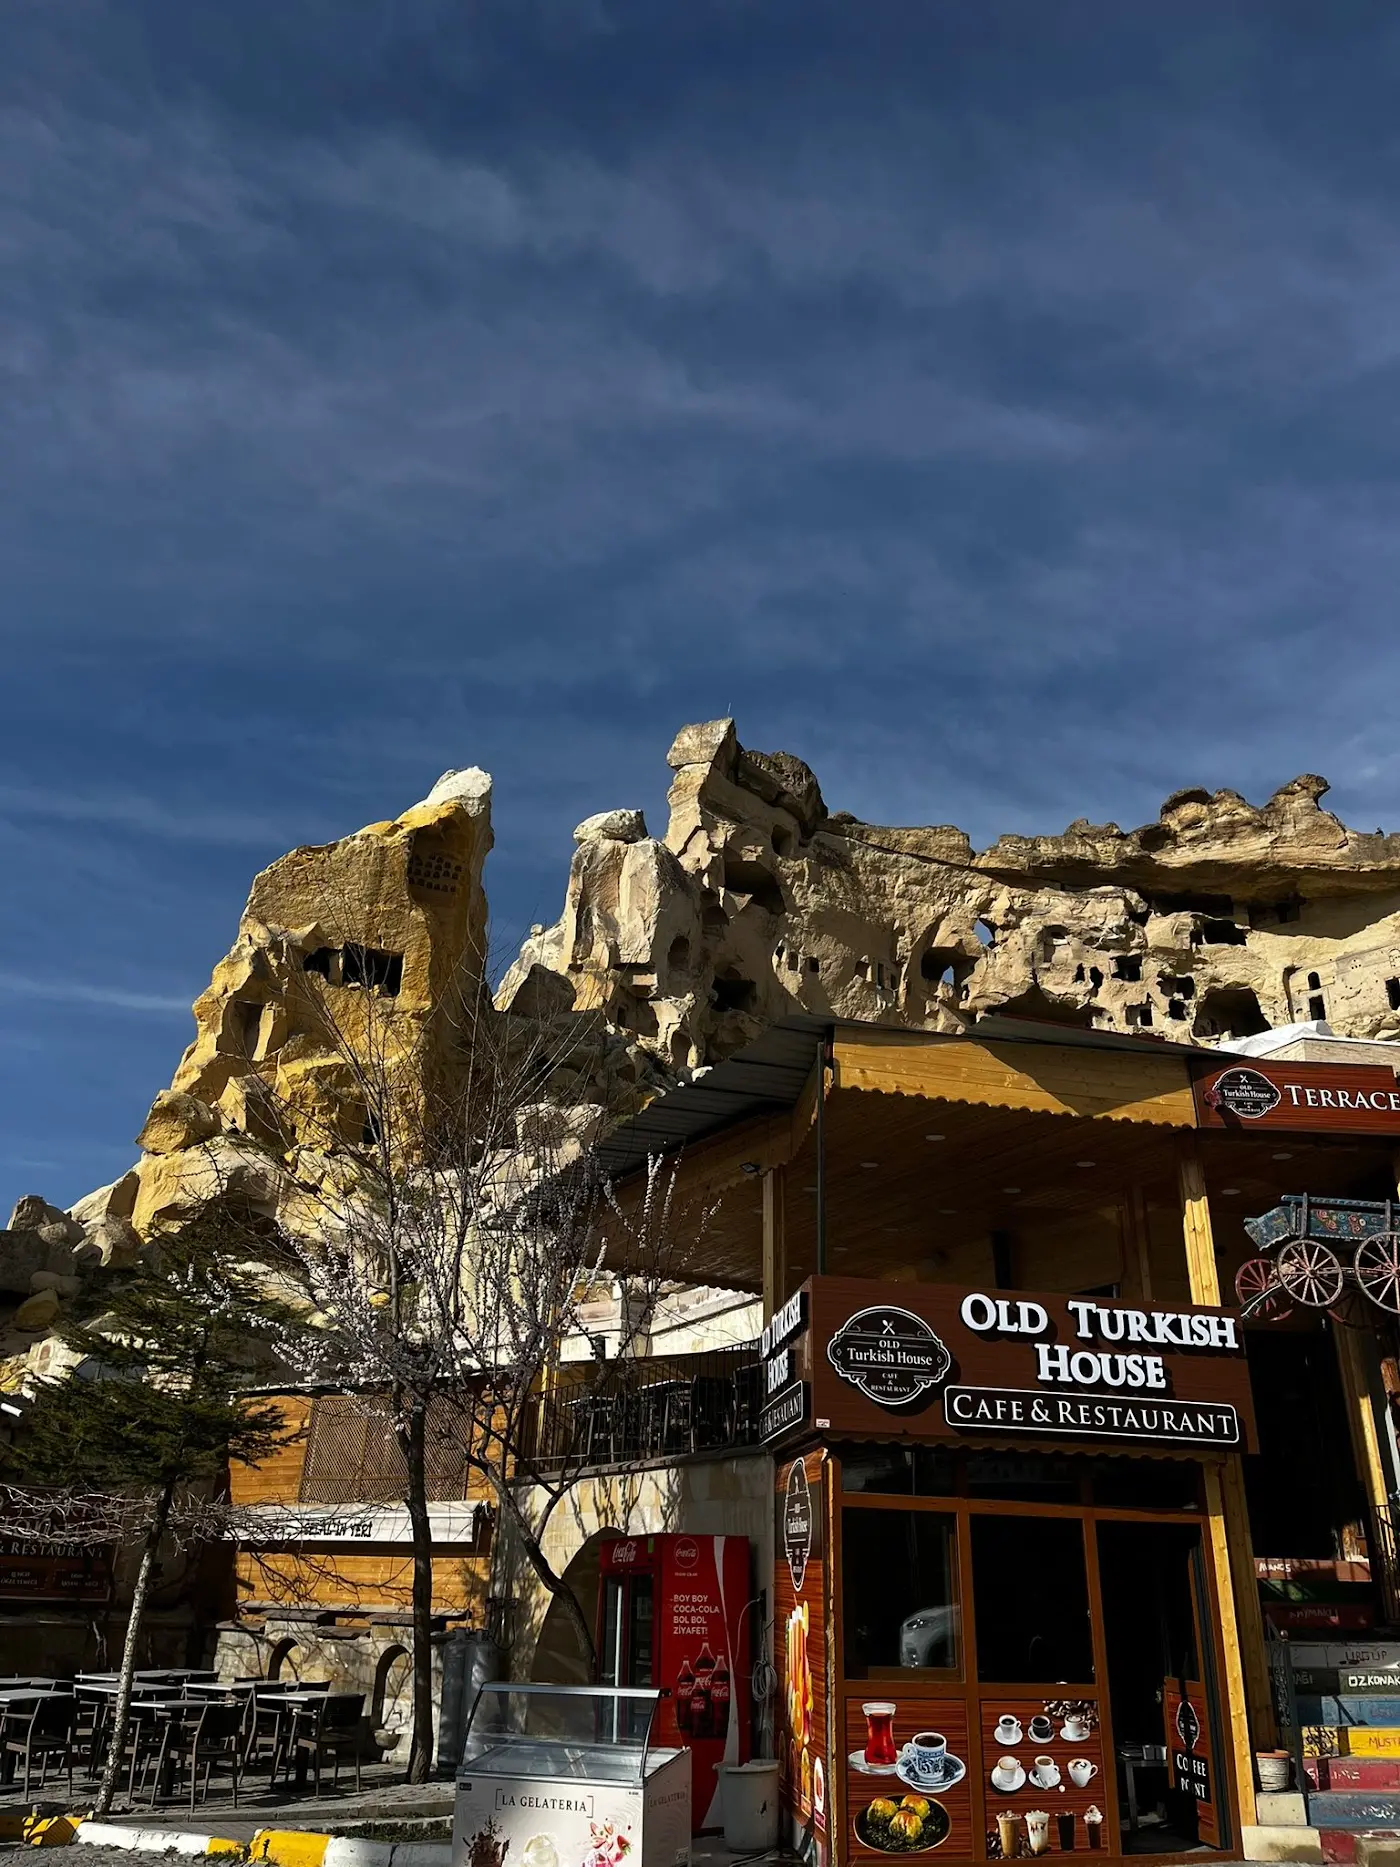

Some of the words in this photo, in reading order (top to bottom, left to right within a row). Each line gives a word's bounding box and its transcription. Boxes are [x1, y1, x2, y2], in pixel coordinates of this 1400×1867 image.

[1222, 1088, 1250, 1098] Turkish
[1251, 1090, 1271, 1099] House
[1284, 1085, 1400, 1111] TERRACE
[961, 1293, 1048, 1334] OLD
[1068, 1300, 1239, 1349] TURKISH
[878, 1339, 901, 1349] OLD
[846, 1347, 895, 1363] Turkish
[897, 1351, 933, 1366] House
[1034, 1343, 1166, 1388] HOUSE
[768, 1348, 788, 1394] HOUSE
[953, 1394, 1024, 1421] CAFE
[1058, 1400, 1232, 1434] RESTAURANT
[673, 1595, 690, 1603] BOY
[692, 1595, 708, 1603] BOY
[673, 1605, 720, 1614] COCA-COLA
[673, 1616, 690, 1624] BOL
[691, 1616, 707, 1624] BOL
[673, 1625, 708, 1635] ZİYAFET!
[1176, 1753, 1206, 1776] COFEE
[1181, 1777, 1205, 1798] PONT
[502, 1794, 516, 1806] LA
[520, 1796, 587, 1812] GELATERIA
